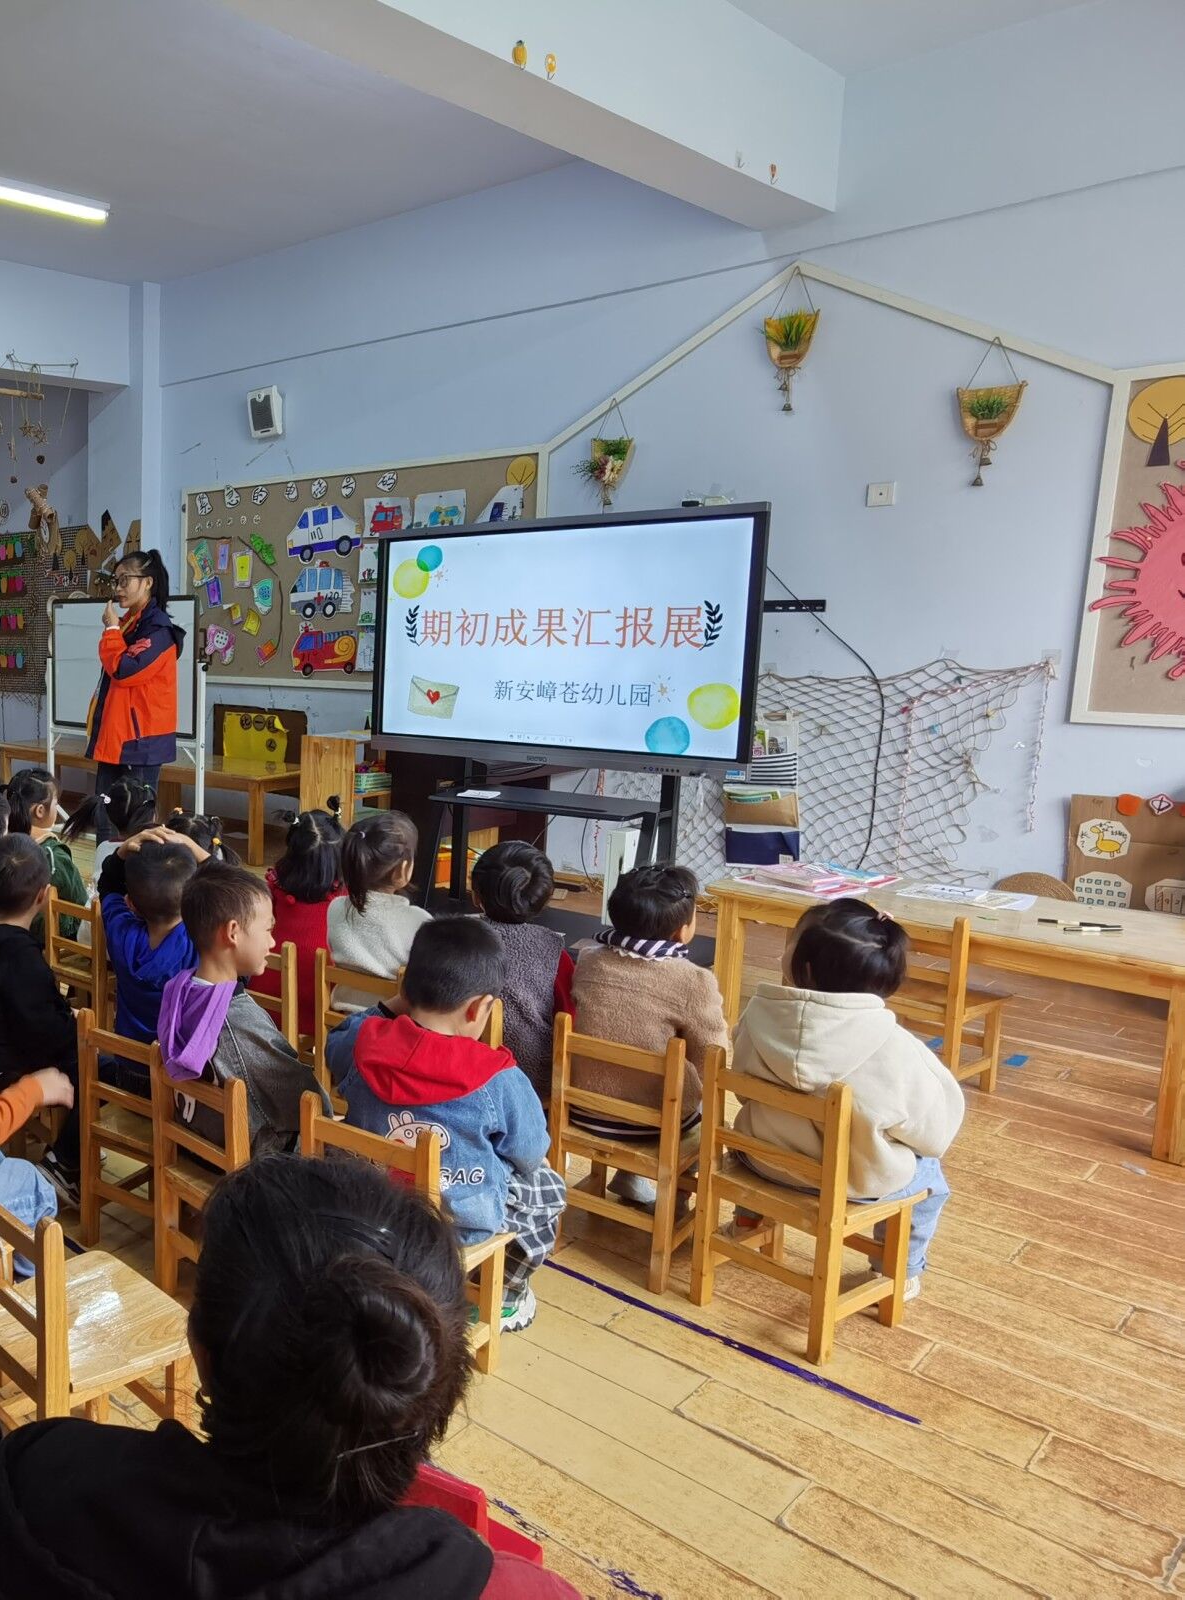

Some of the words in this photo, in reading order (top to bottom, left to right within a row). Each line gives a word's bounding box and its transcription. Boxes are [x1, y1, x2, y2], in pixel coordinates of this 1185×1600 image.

[419, 606, 705, 648] 期初成果汇报展
[494, 680, 653, 707] 新安嶂苍幼儿园
